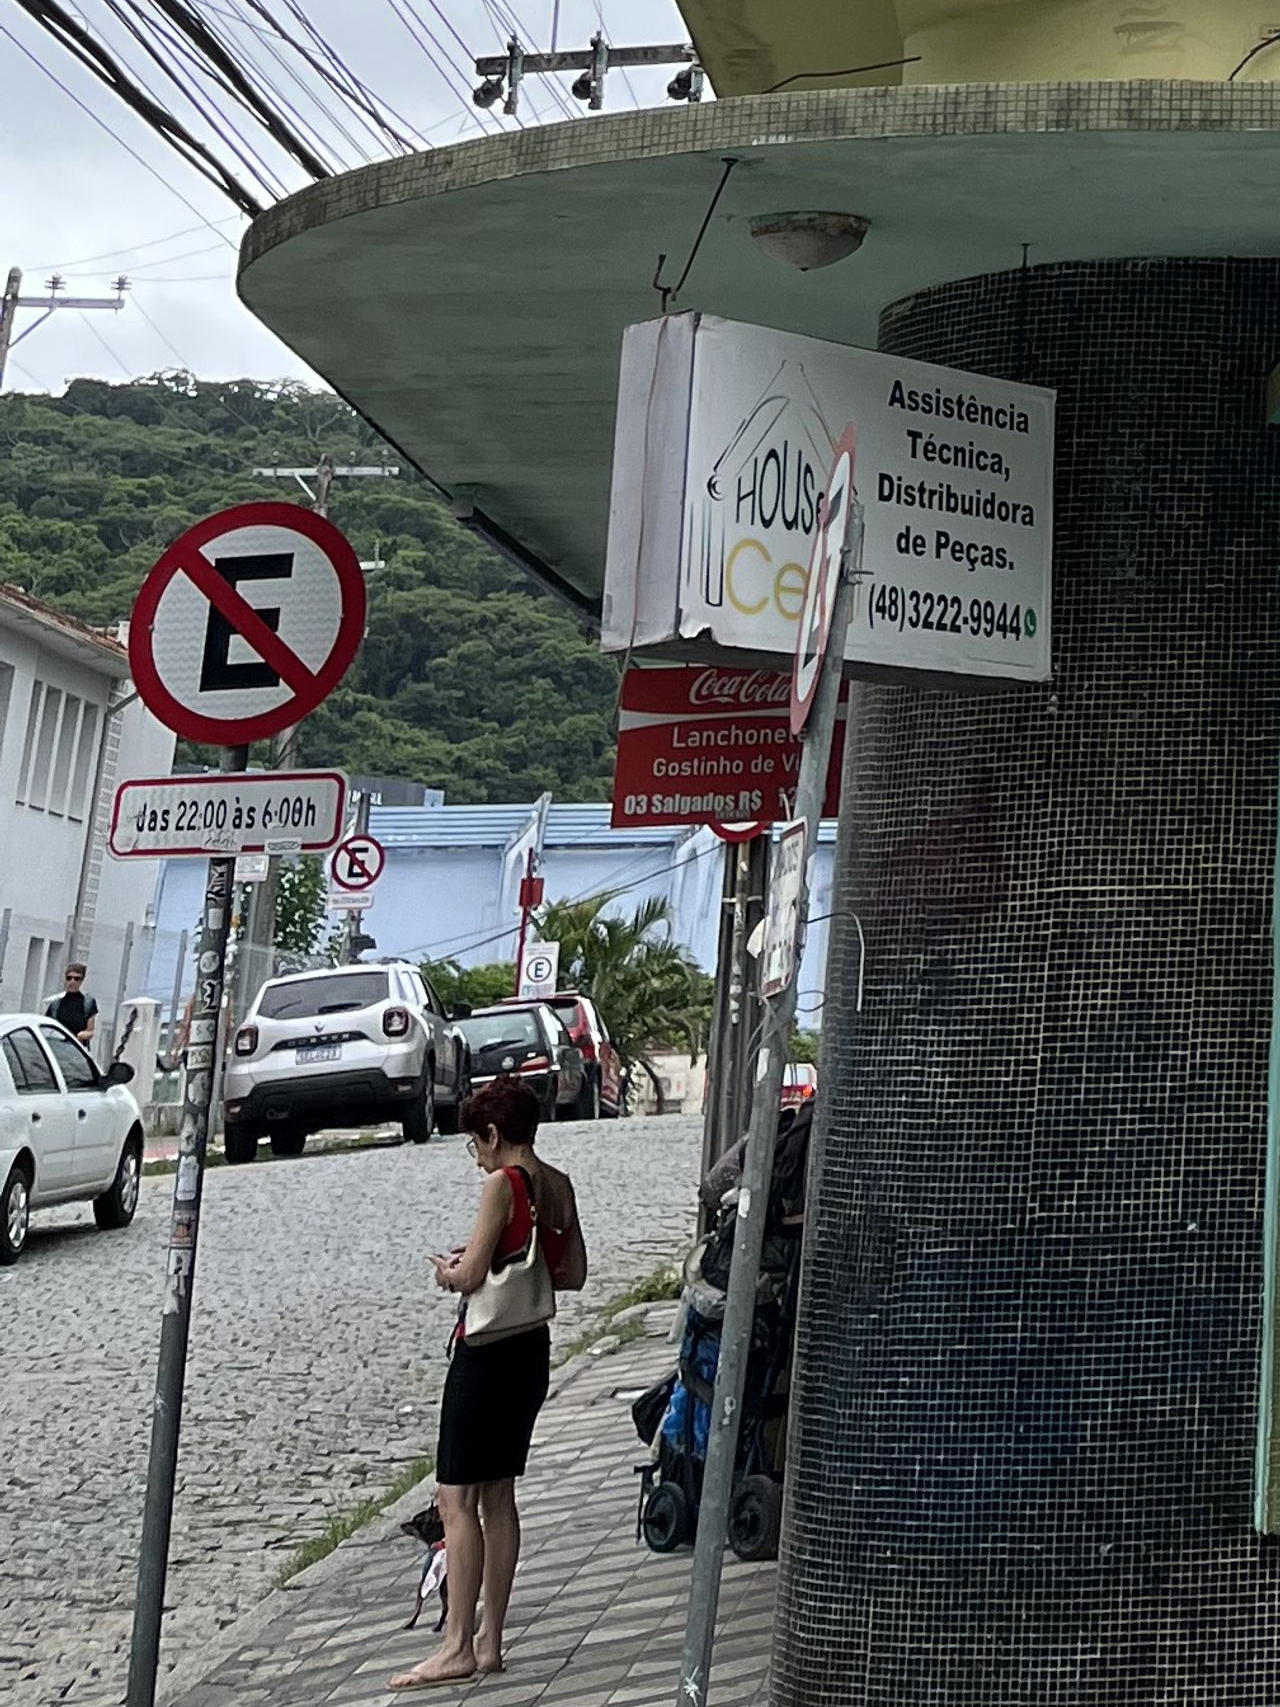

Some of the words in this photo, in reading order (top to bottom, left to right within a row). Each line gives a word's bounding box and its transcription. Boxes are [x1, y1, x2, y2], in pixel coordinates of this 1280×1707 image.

[888, 379, 1030, 434] Assistência
[906, 429, 1011, 482] Técnica,
[878, 472, 1035, 527] Distribuidora
[896, 525, 927, 557] de
[935, 530, 1015, 573] Peças.
[199, 553, 294, 692] E
[868, 583, 1022, 642] (48)3222-9944
[652, 754, 744, 777] Gostinho
[751, 754, 775, 773] de
[136, 803, 171, 832] das
[175, 800, 227, 831] 22:00
[232, 796, 256, 829] às
[624, 794, 648, 816] 03
[651, 791, 735, 816] Salgados
[739, 789, 763, 812] R$
[534, 961, 545, 978] E
